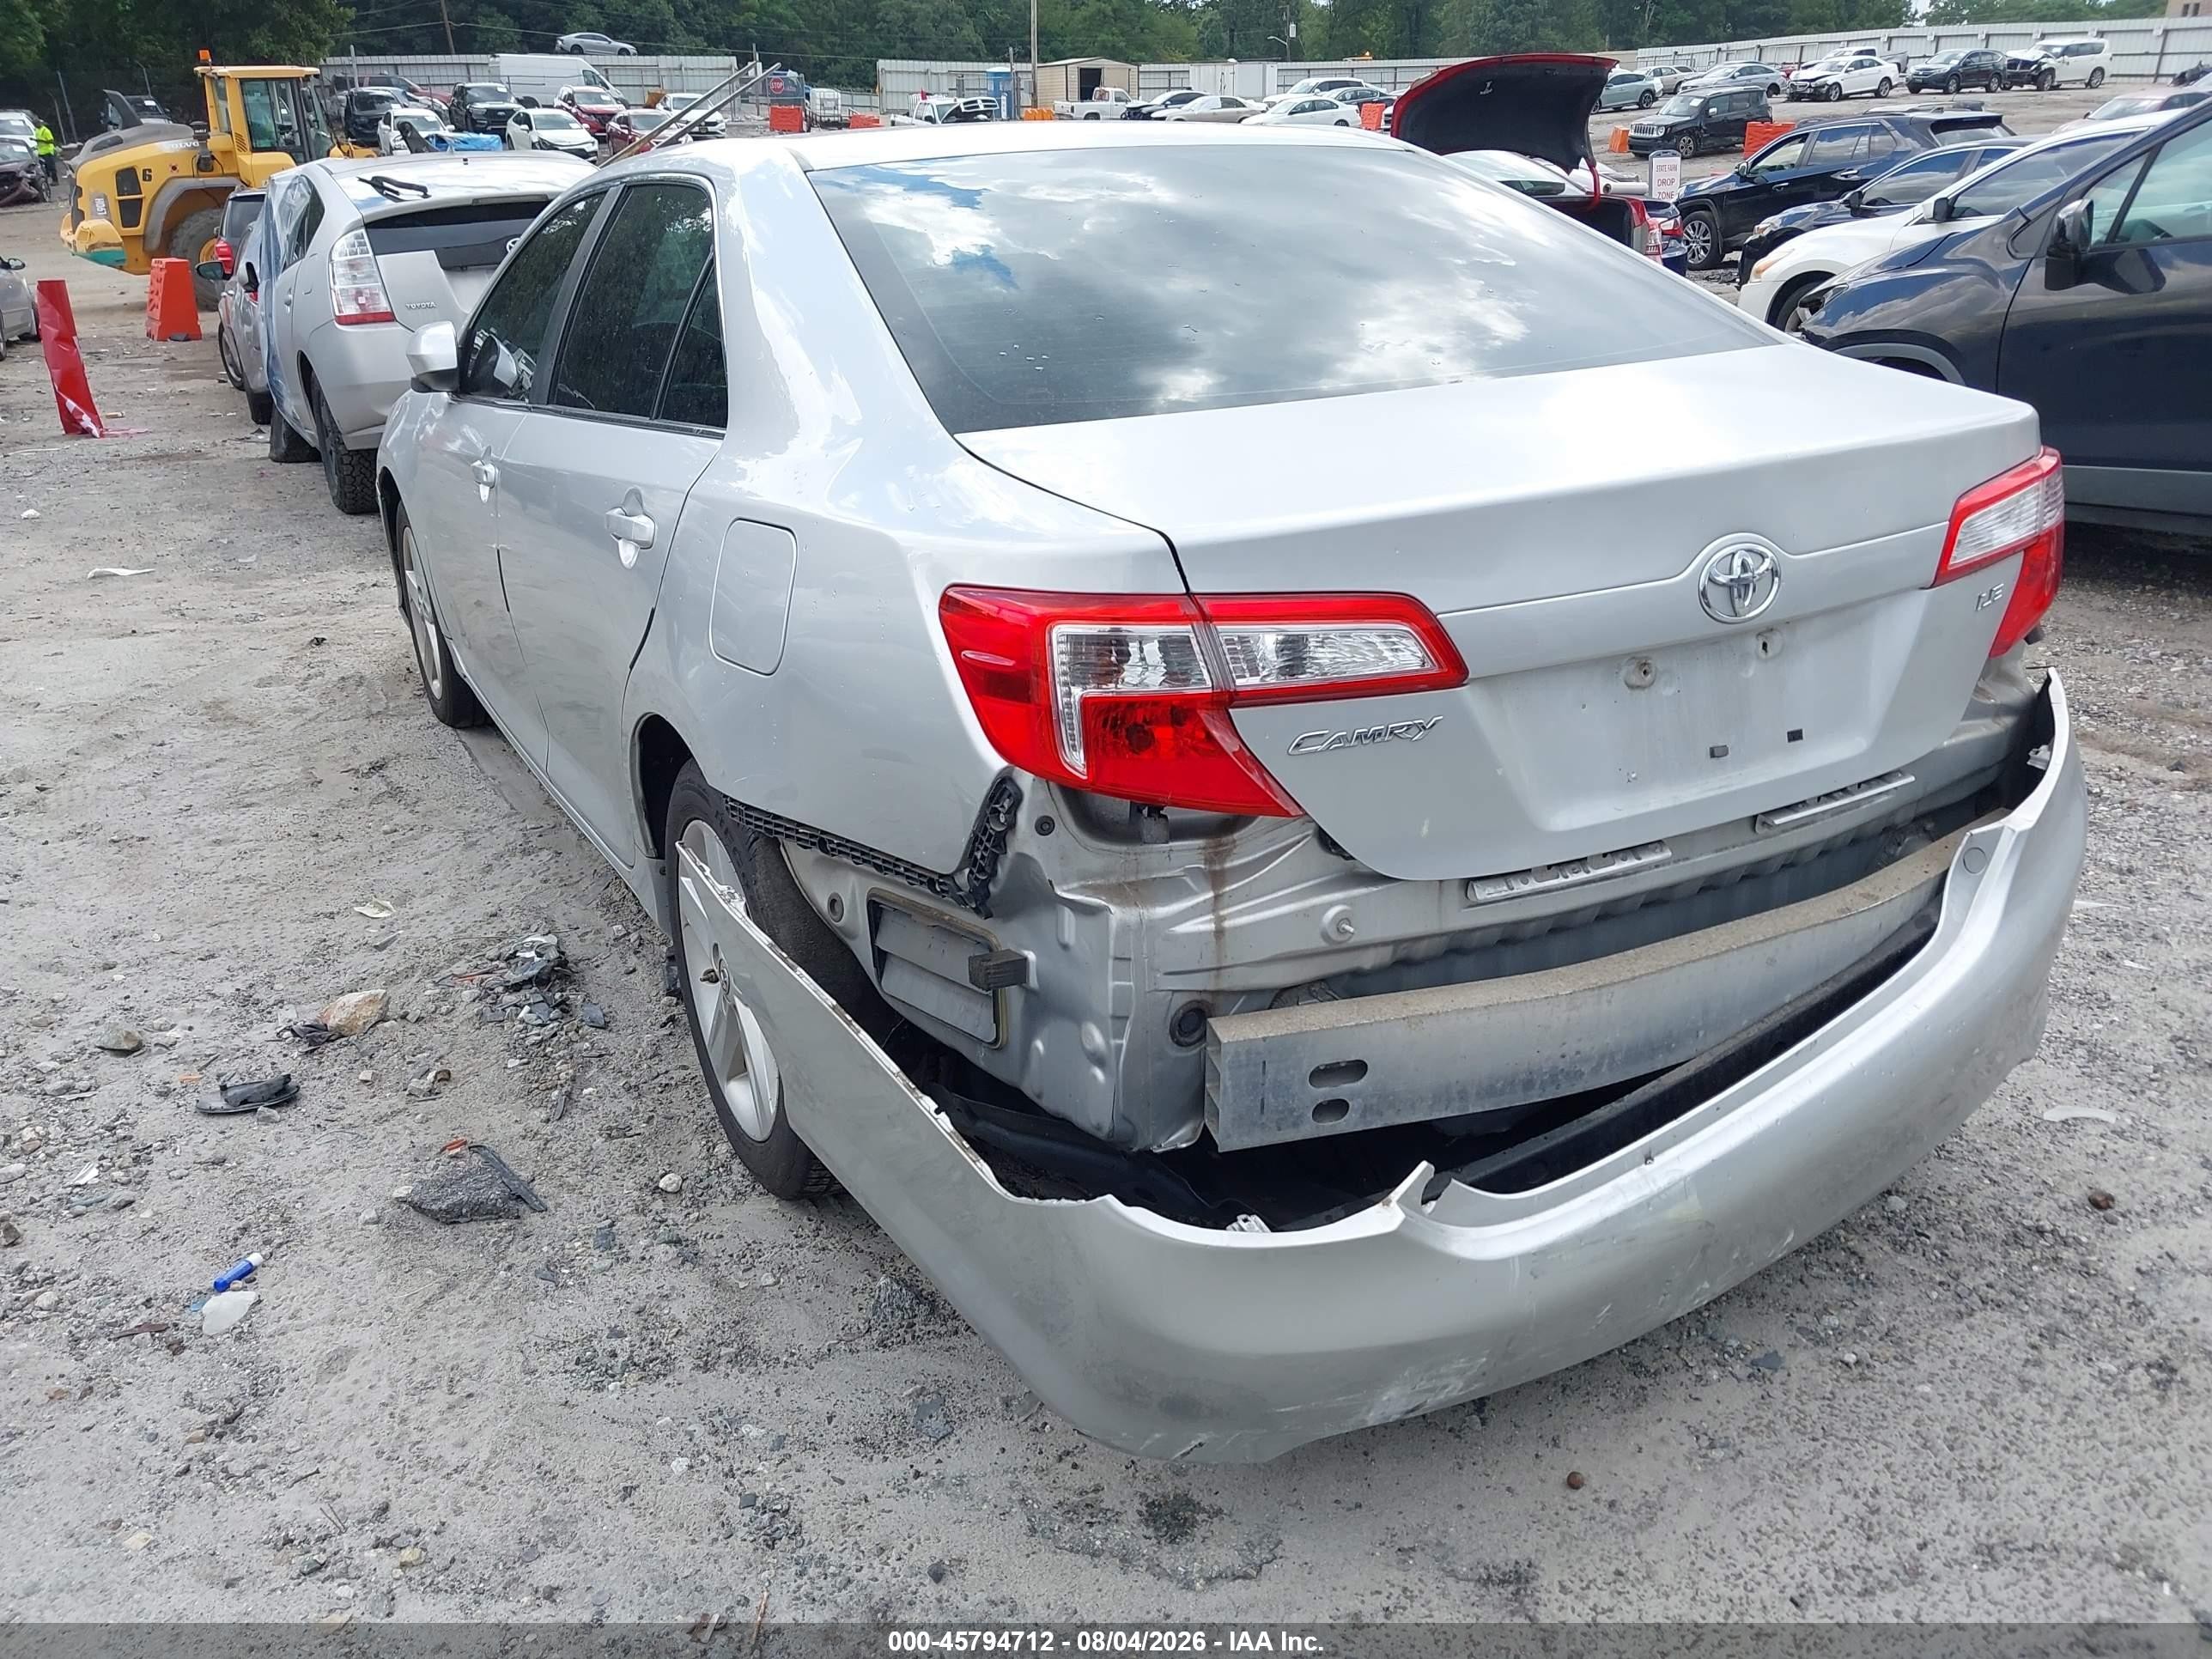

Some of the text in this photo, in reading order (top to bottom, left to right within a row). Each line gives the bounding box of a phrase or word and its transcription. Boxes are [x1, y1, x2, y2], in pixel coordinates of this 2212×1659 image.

[164, 140, 199, 150] OLVO
[143, 168, 152, 181] 6
[1657, 178, 1675, 187] DROP
[1657, 191, 1674, 200] ZONE
[405, 301, 436, 310] TOYOTA
[1975, 583, 2004, 611] LE
[1287, 715, 1443, 756] CAMRY
